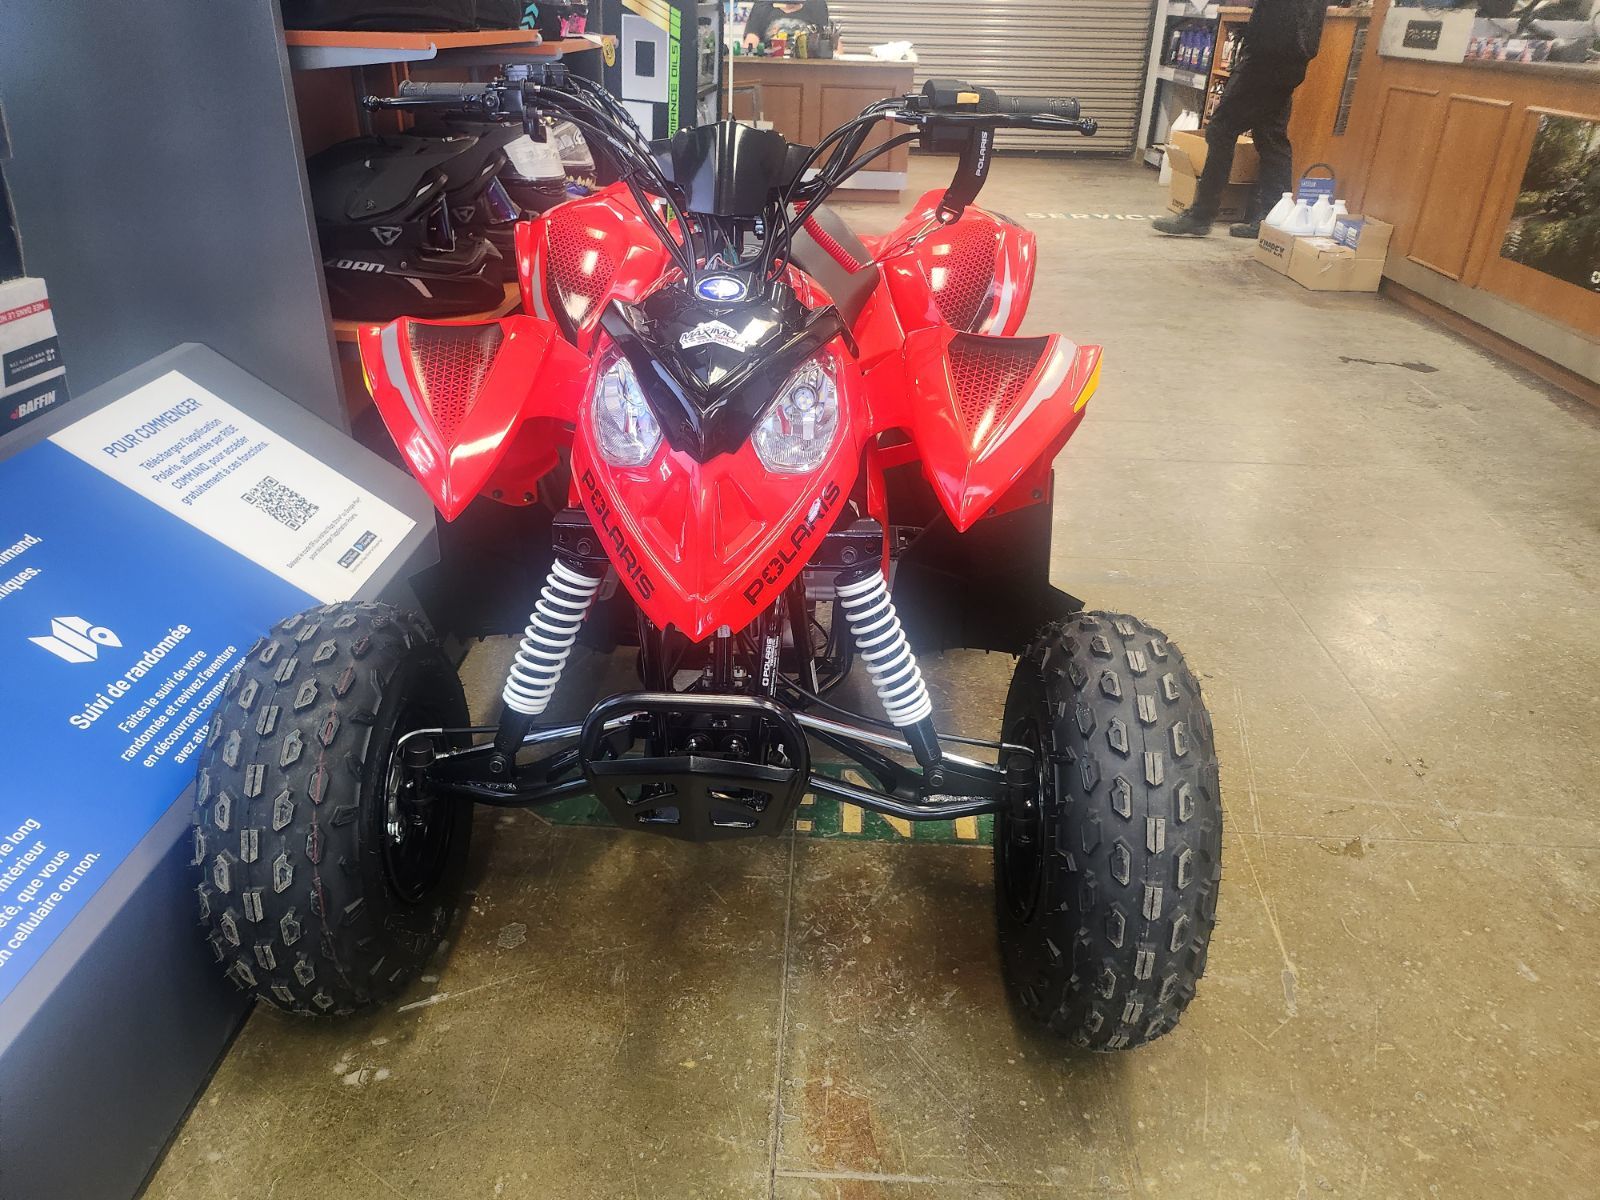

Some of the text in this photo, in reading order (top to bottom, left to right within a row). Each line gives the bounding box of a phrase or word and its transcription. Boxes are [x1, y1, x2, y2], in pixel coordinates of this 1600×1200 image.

[670, 84, 679, 134] MANCE
[975, 131, 988, 176] POLARIS
[18, 390, 56, 418] BAFFIN
[102, 397, 203, 459] POUR COMMENCER
[139, 418, 223, 472] Téléchargez l'application
[152, 460, 185, 484] Polaris,
[180, 441, 214, 467] alimentée
[211, 433, 224, 446] par
[171, 436, 249, 490] COMMAND, pour accéder
[181, 467, 226, 506] gratuitement
[227, 459, 241, 472] ces
[236, 440, 270, 464] fonctions.
[581, 470, 655, 600] POLARIS
[743, 481, 841, 606] POLARIS
[69, 623, 192, 730] Suivi de randonnée
[763, 636, 773, 677] POLARIS
[117, 650, 207, 733] Faites le suivi de votre
[120, 645, 237, 762] randonnée et revivez l'aventure
[143, 753, 159, 767] en
[154, 707, 203, 756] découvrant
[198, 672, 231, 710] comment
[174, 720, 210, 764] avez atta
[5, 818, 41, 844] long
[0, 840, 47, 893] ntérieur
[17, 878, 44, 903] que
[38, 850, 70, 879] vous
[8, 891, 63, 949] cellulaire
[58, 874, 79, 892] ou
[76, 852, 101, 877] non.
